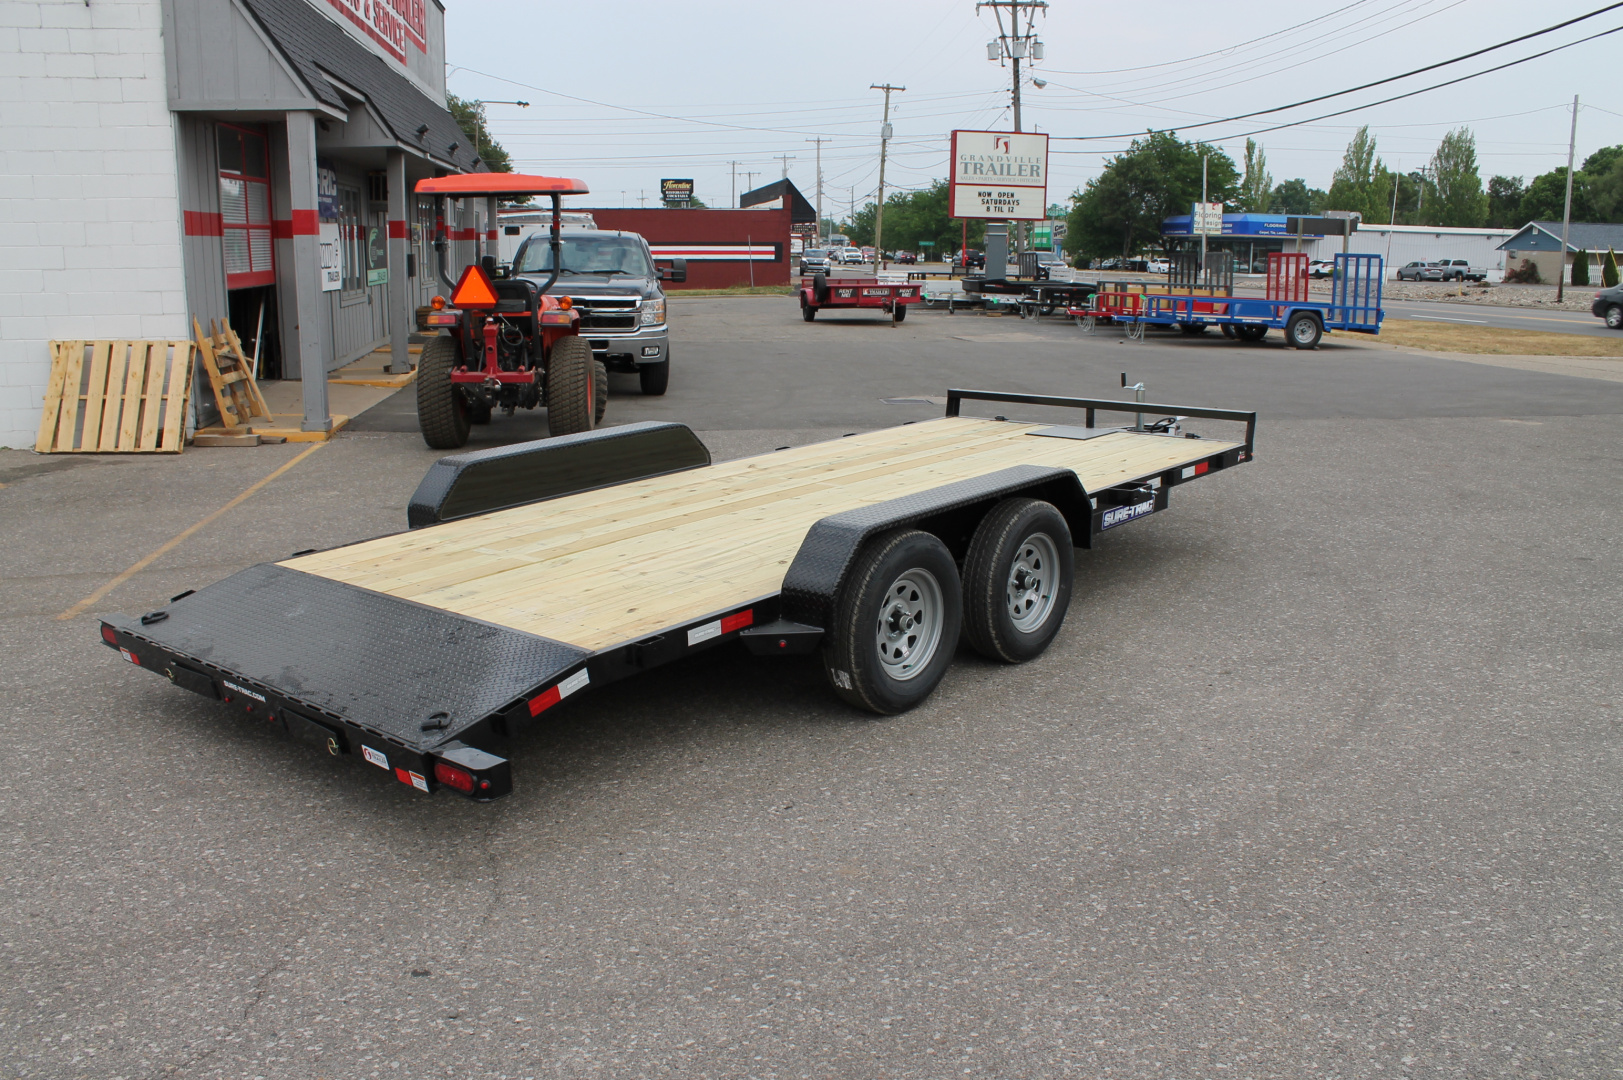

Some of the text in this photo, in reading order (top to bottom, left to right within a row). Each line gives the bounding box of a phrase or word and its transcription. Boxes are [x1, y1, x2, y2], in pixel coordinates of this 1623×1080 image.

[374, 0, 404, 52] SERVICE
[960, 154, 1041, 164] GRANDVILLE
[960, 162, 1040, 177] TRAILER
[1104, 499, 1154, 527] SURE-TRAC
[224, 680, 266, 702] SURE-TRAC.COM
